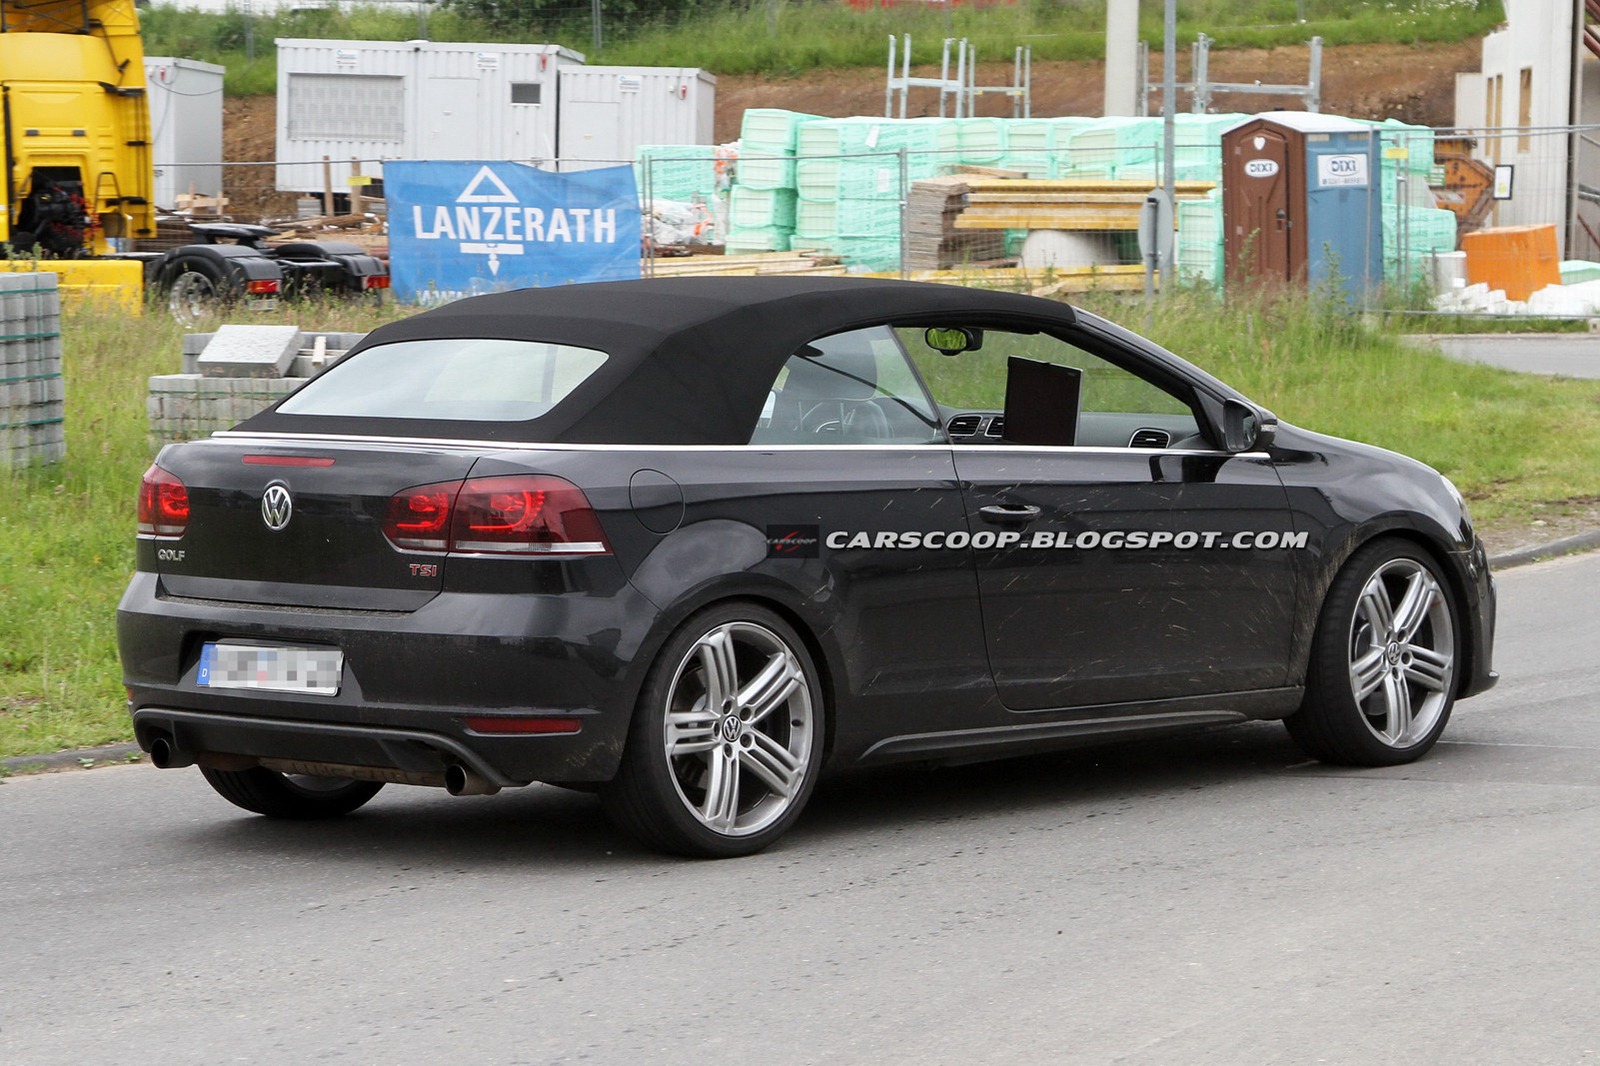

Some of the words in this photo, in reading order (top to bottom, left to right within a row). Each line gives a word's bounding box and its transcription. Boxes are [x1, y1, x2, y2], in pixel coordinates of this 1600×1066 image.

[413, 205, 616, 243] LANZERATH
[158, 549, 186, 562] GOLF
[409, 563, 438, 577] TSI
[201, 668, 208, 678] D
